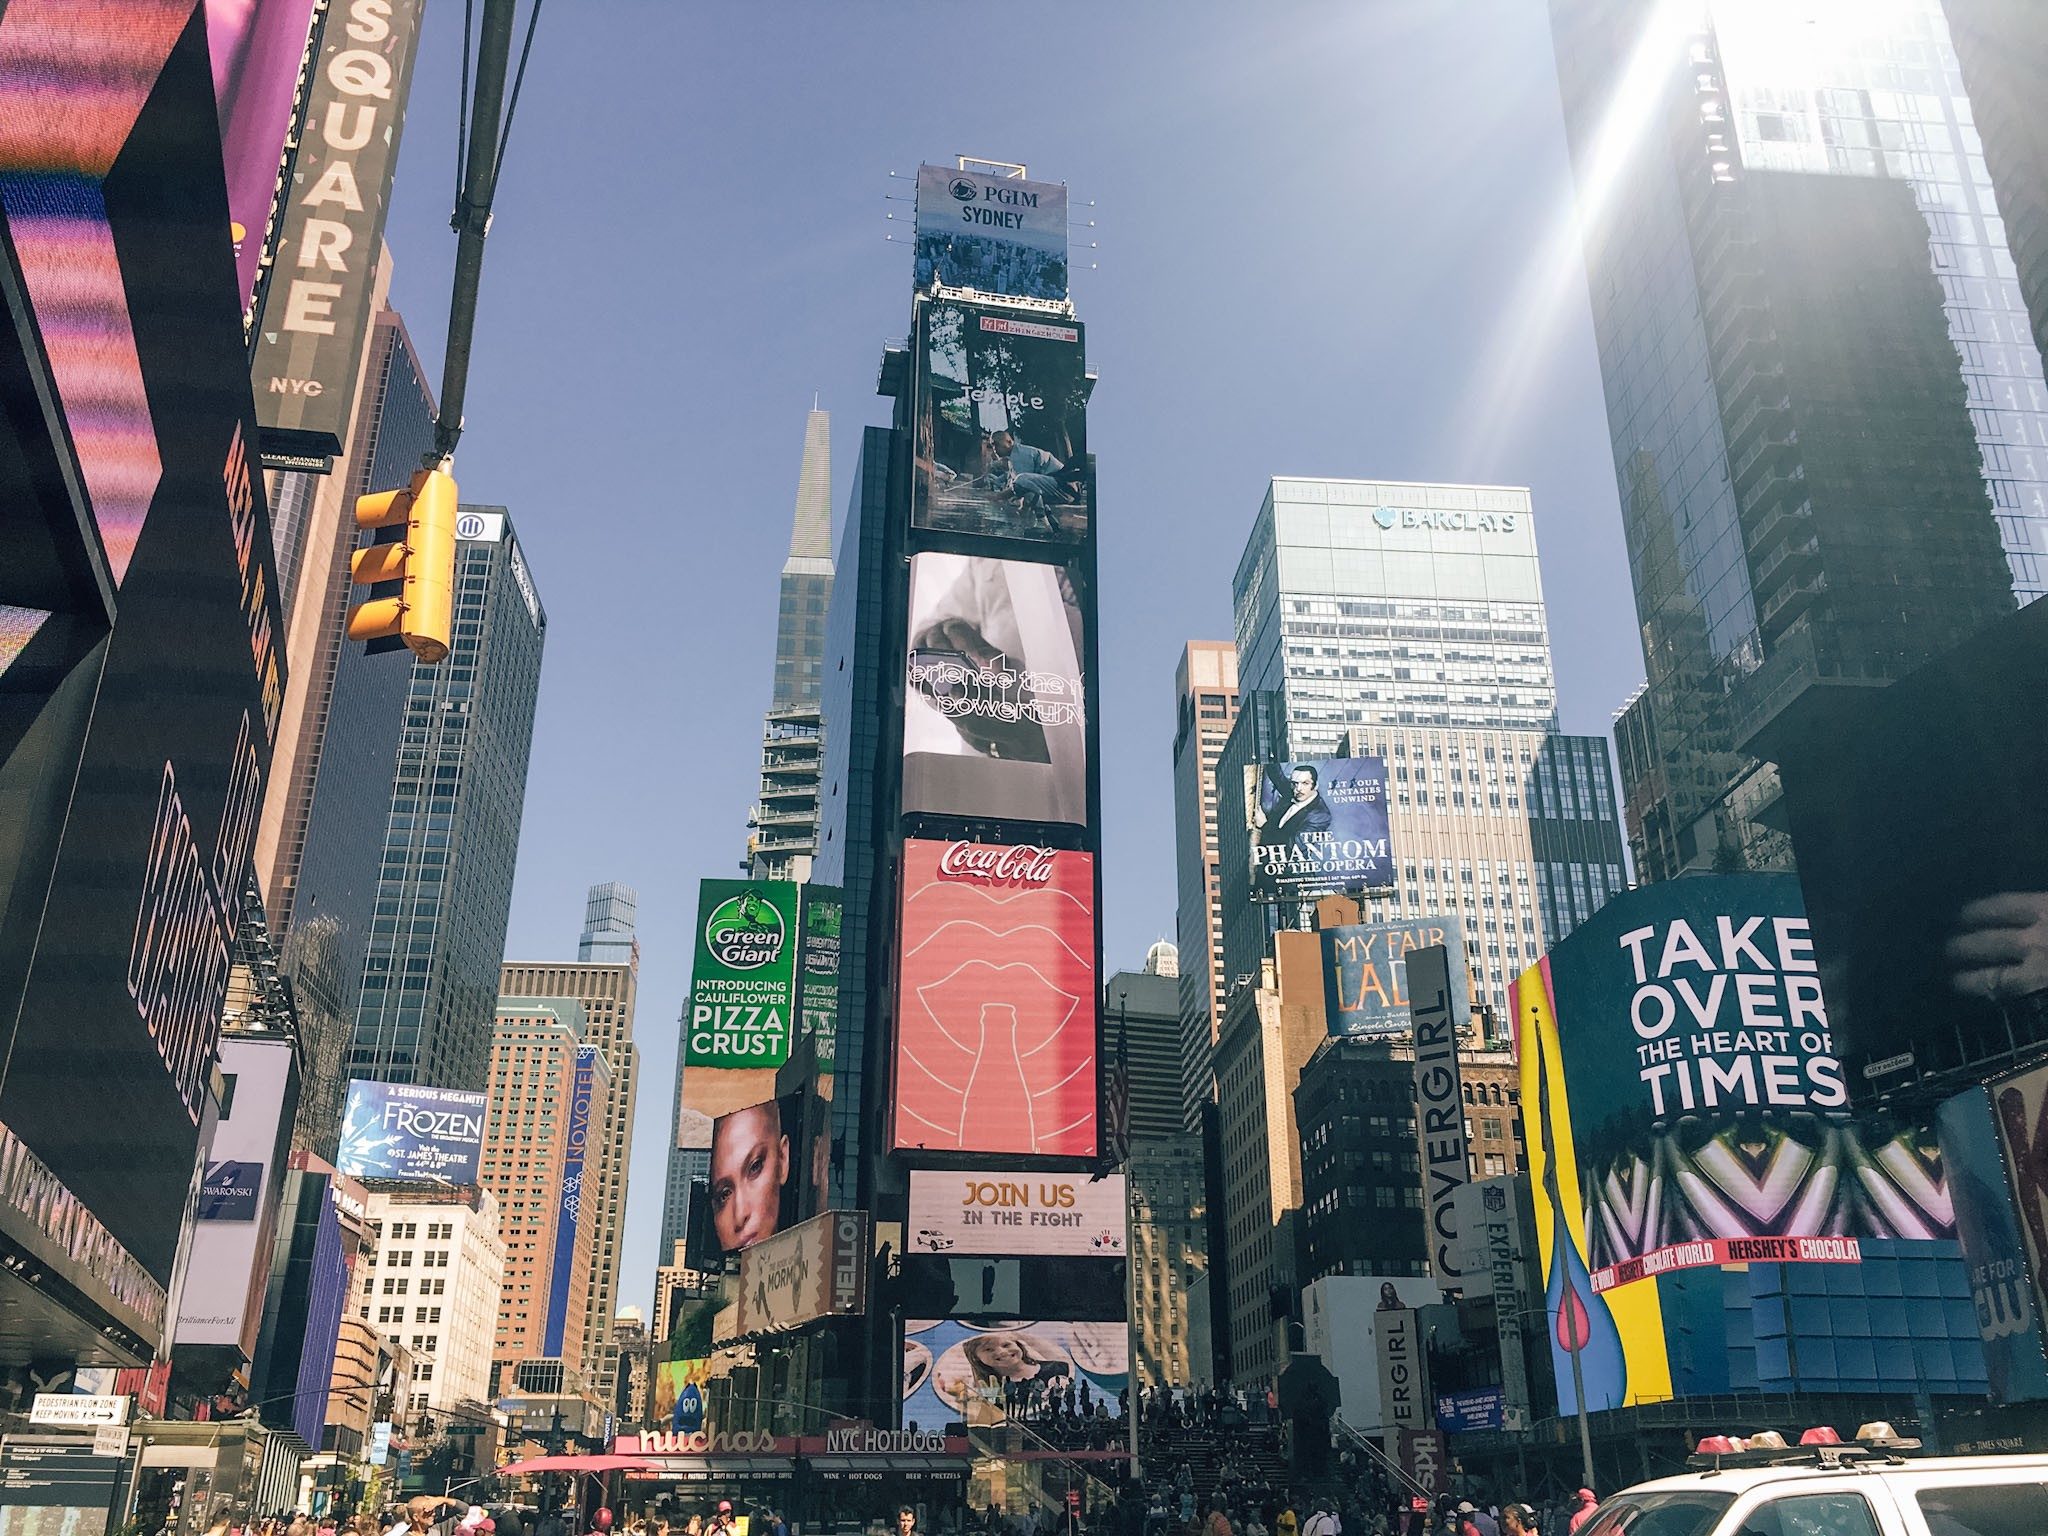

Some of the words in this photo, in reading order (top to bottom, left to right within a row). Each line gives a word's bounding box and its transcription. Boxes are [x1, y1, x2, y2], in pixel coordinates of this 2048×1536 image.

[283, 0, 392, 335] SQUARE
[983, 187, 1039, 208] PGIM
[962, 205, 1024, 230] SYDNEY
[268, 376, 323, 397] NYC
[960, 385, 1044, 410] Temple
[1402, 510, 1517, 532] BARCLAYS
[1327, 786, 1381, 797] FANTASIES
[1334, 795, 1375, 803] UNWIND
[1300, 831, 1334, 843] THE
[939, 840, 1059, 884] Coca-Cola
[1251, 839, 1388, 865] PHANTOM
[1265, 864, 1286, 876] OF
[1288, 861, 1321, 874] THE
[1323, 859, 1376, 872] OPERA
[716, 928, 780, 945] Green
[1334, 934, 1377, 962] MY
[1387, 928, 1444, 959] FAIR
[722, 945, 780, 963] Giant
[1619, 915, 1818, 984] TAKE
[696, 980, 786, 991] INTRODUCING
[695, 993, 786, 1005] CAULIFLOWER
[1631, 973, 1829, 1039] OVER
[692, 1005, 784, 1031] PIZZA
[691, 1032, 784, 1056] CRUST
[1637, 1037, 1683, 1066] THE
[1690, 1030, 1790, 1055] HEART
[1800, 1032, 1833, 1054] OF
[398, 1088, 438, 1099] SERIOUS
[1640, 1054, 1847, 1116] TIMES
[383, 1102, 482, 1138] FROZEN
[566, 1059, 594, 1164] NOVOTEL
[407, 1150, 432, 1160] JAMES
[434, 1152, 468, 1163] THEATRE
[203, 1187, 252, 1197] SWAROVSKI
[962, 1182, 1028, 1207] JOIN
[1040, 1183, 1075, 1207] US
[962, 1210, 982, 1225] IN
[991, 1211, 1023, 1226] THE
[1030, 1212, 1083, 1227] FIGHT
[1643, 1252, 1676, 1275] CHOCOLATE
[1675, 1242, 1714, 1265] WORLD
[1727, 1240, 1798, 1260] HERSHEY'S
[1488, 1222, 1520, 1341] EXPERIENCE
[38, 1398, 78, 1408] PEDESTRIAN
[80, 1399, 98, 1408] FLOW
[99, 1399, 117, 1409] ZONE
[35, 1410, 53, 1418] KEEP
[54, 1411, 80, 1419] MOVING
[603, 1416, 612, 1449] NOVOTEL
[640, 1422, 777, 1452] nuchas
[827, 1430, 860, 1451] NYC
[1996, 1437, 2024, 1450] SQUARE
[864, 1472, 883, 1480] DOGS
[905, 1472, 922, 1480] BEER
[930, 1472, 961, 1480] PRETZELS
